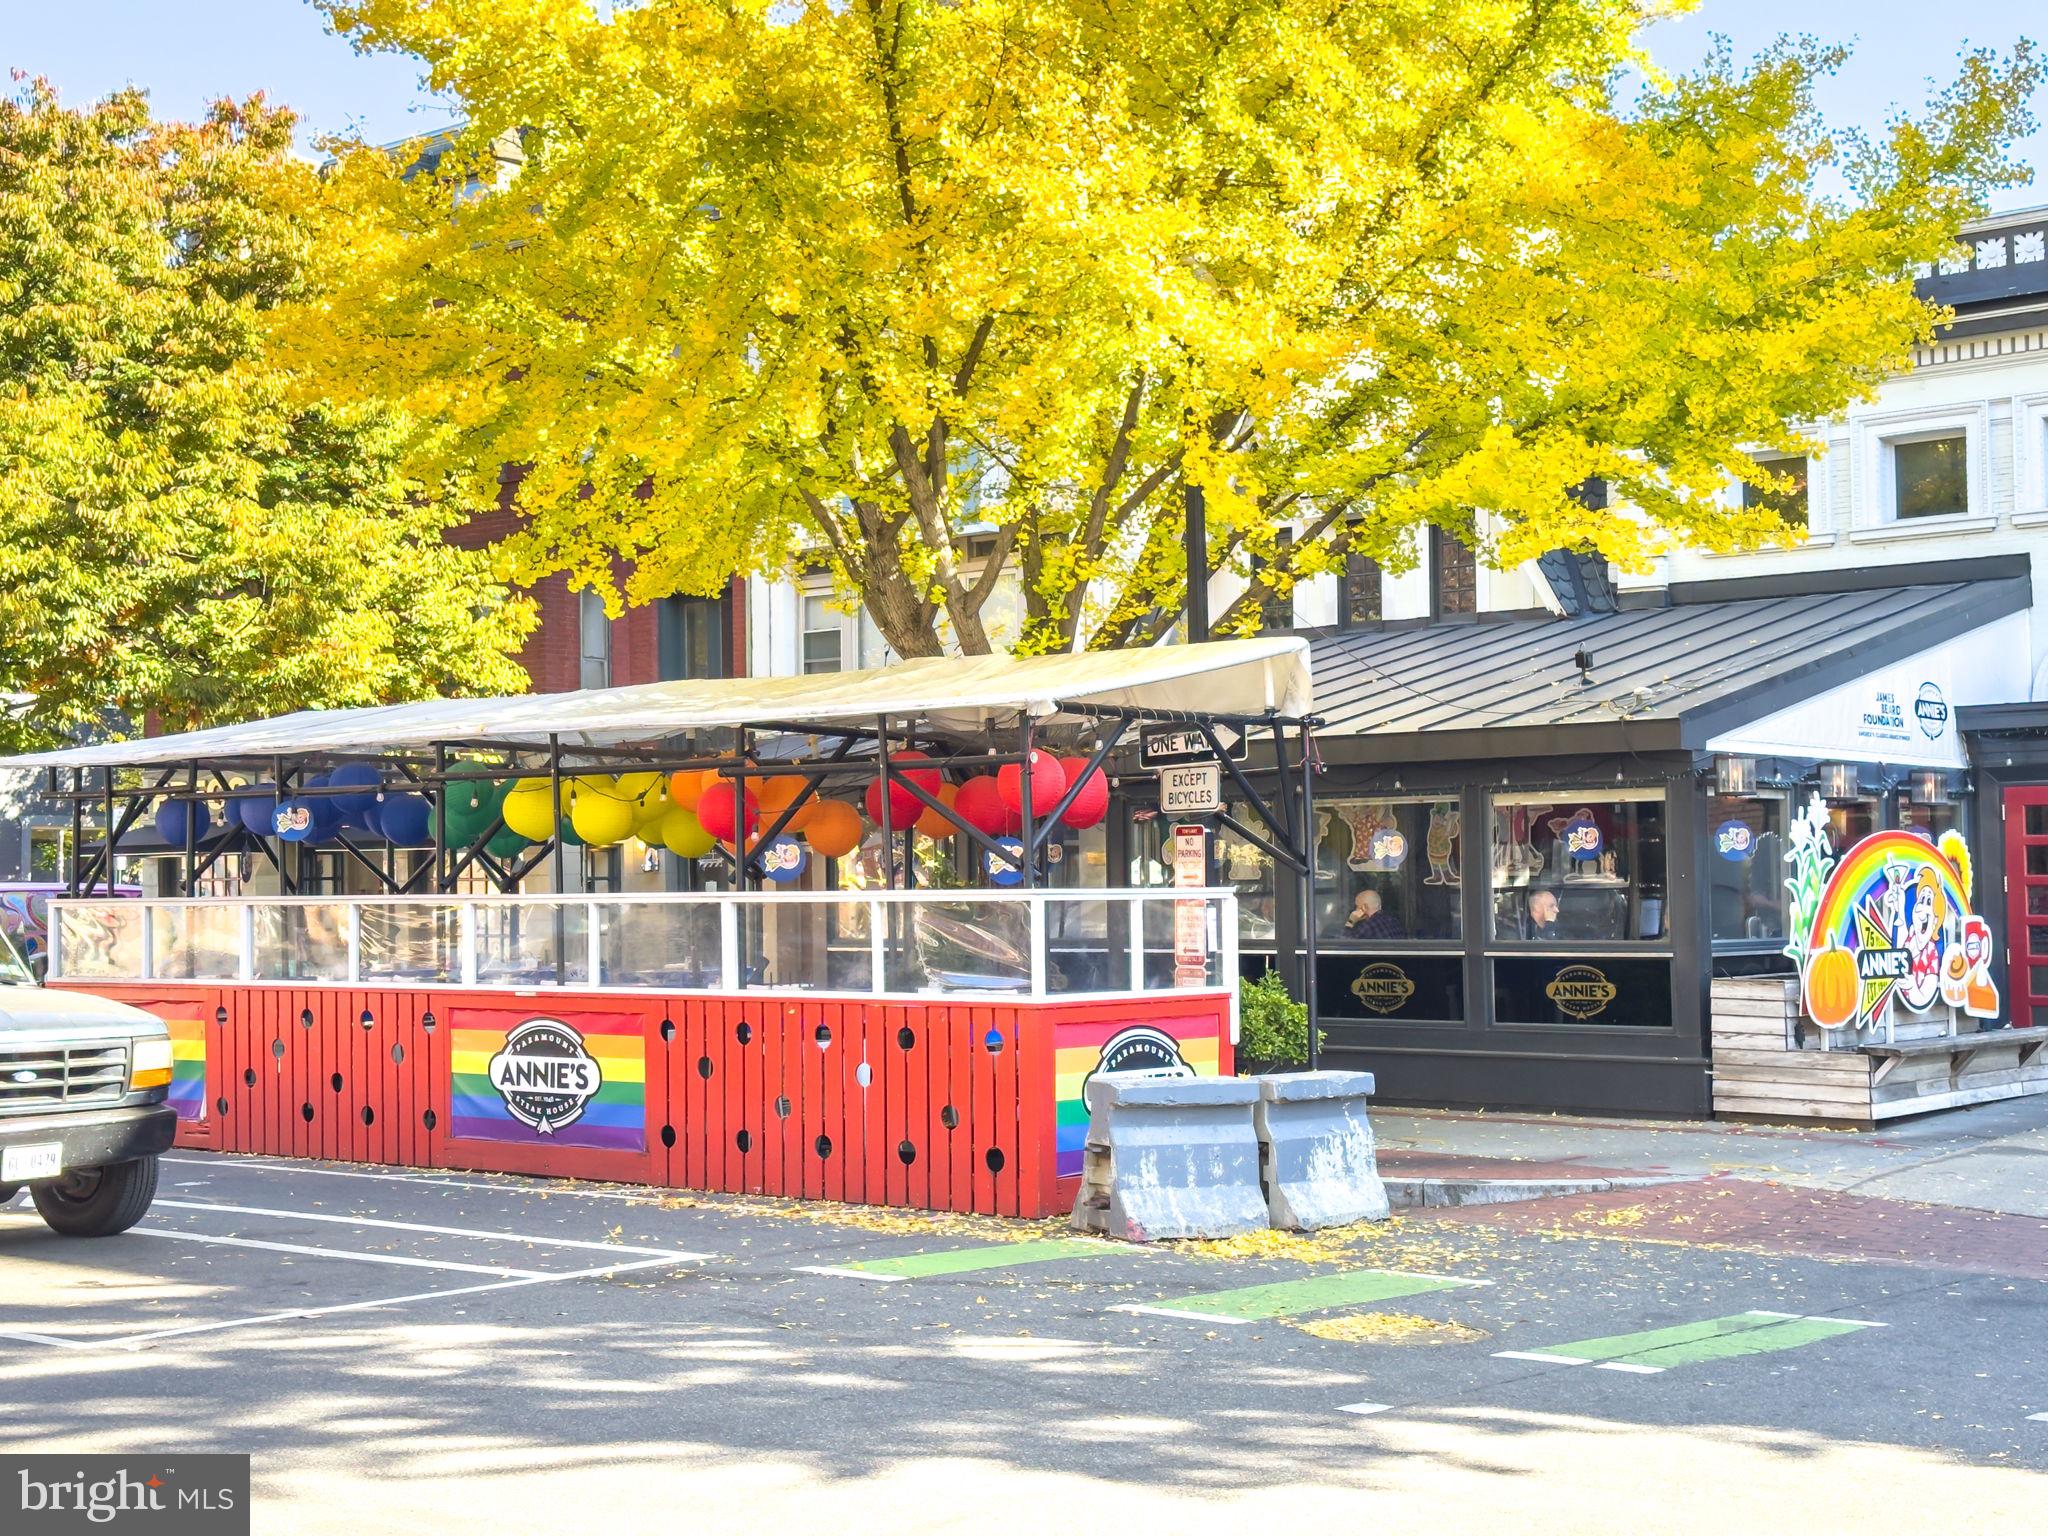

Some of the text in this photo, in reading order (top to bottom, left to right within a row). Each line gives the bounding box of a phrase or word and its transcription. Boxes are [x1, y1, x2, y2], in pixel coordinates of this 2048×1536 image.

[1876, 692, 1895, 703] JAMES
[1863, 714, 1904, 728] FOUNDATION
[1151, 732, 1213, 754] ONE WA
[1172, 772, 1207, 787] EXCEPT
[1168, 790, 1212, 805] BICYCLES
[1184, 837, 1194, 847] NO
[1177, 849, 1202, 858] PARKING
[1865, 927, 1875, 947] 75
[1861, 951, 1909, 977] ANNIE'S
[1358, 981, 1409, 994] ANNIE'S
[1552, 984, 1610, 998] ANNIE'S
[516, 1033, 574, 1054] PARAMOUNT
[1110, 1044, 1171, 1068] PARAMOUNT
[500, 1060, 589, 1091] ANNIE'S
[515, 1095, 575, 1115] STEAK HOUSE
